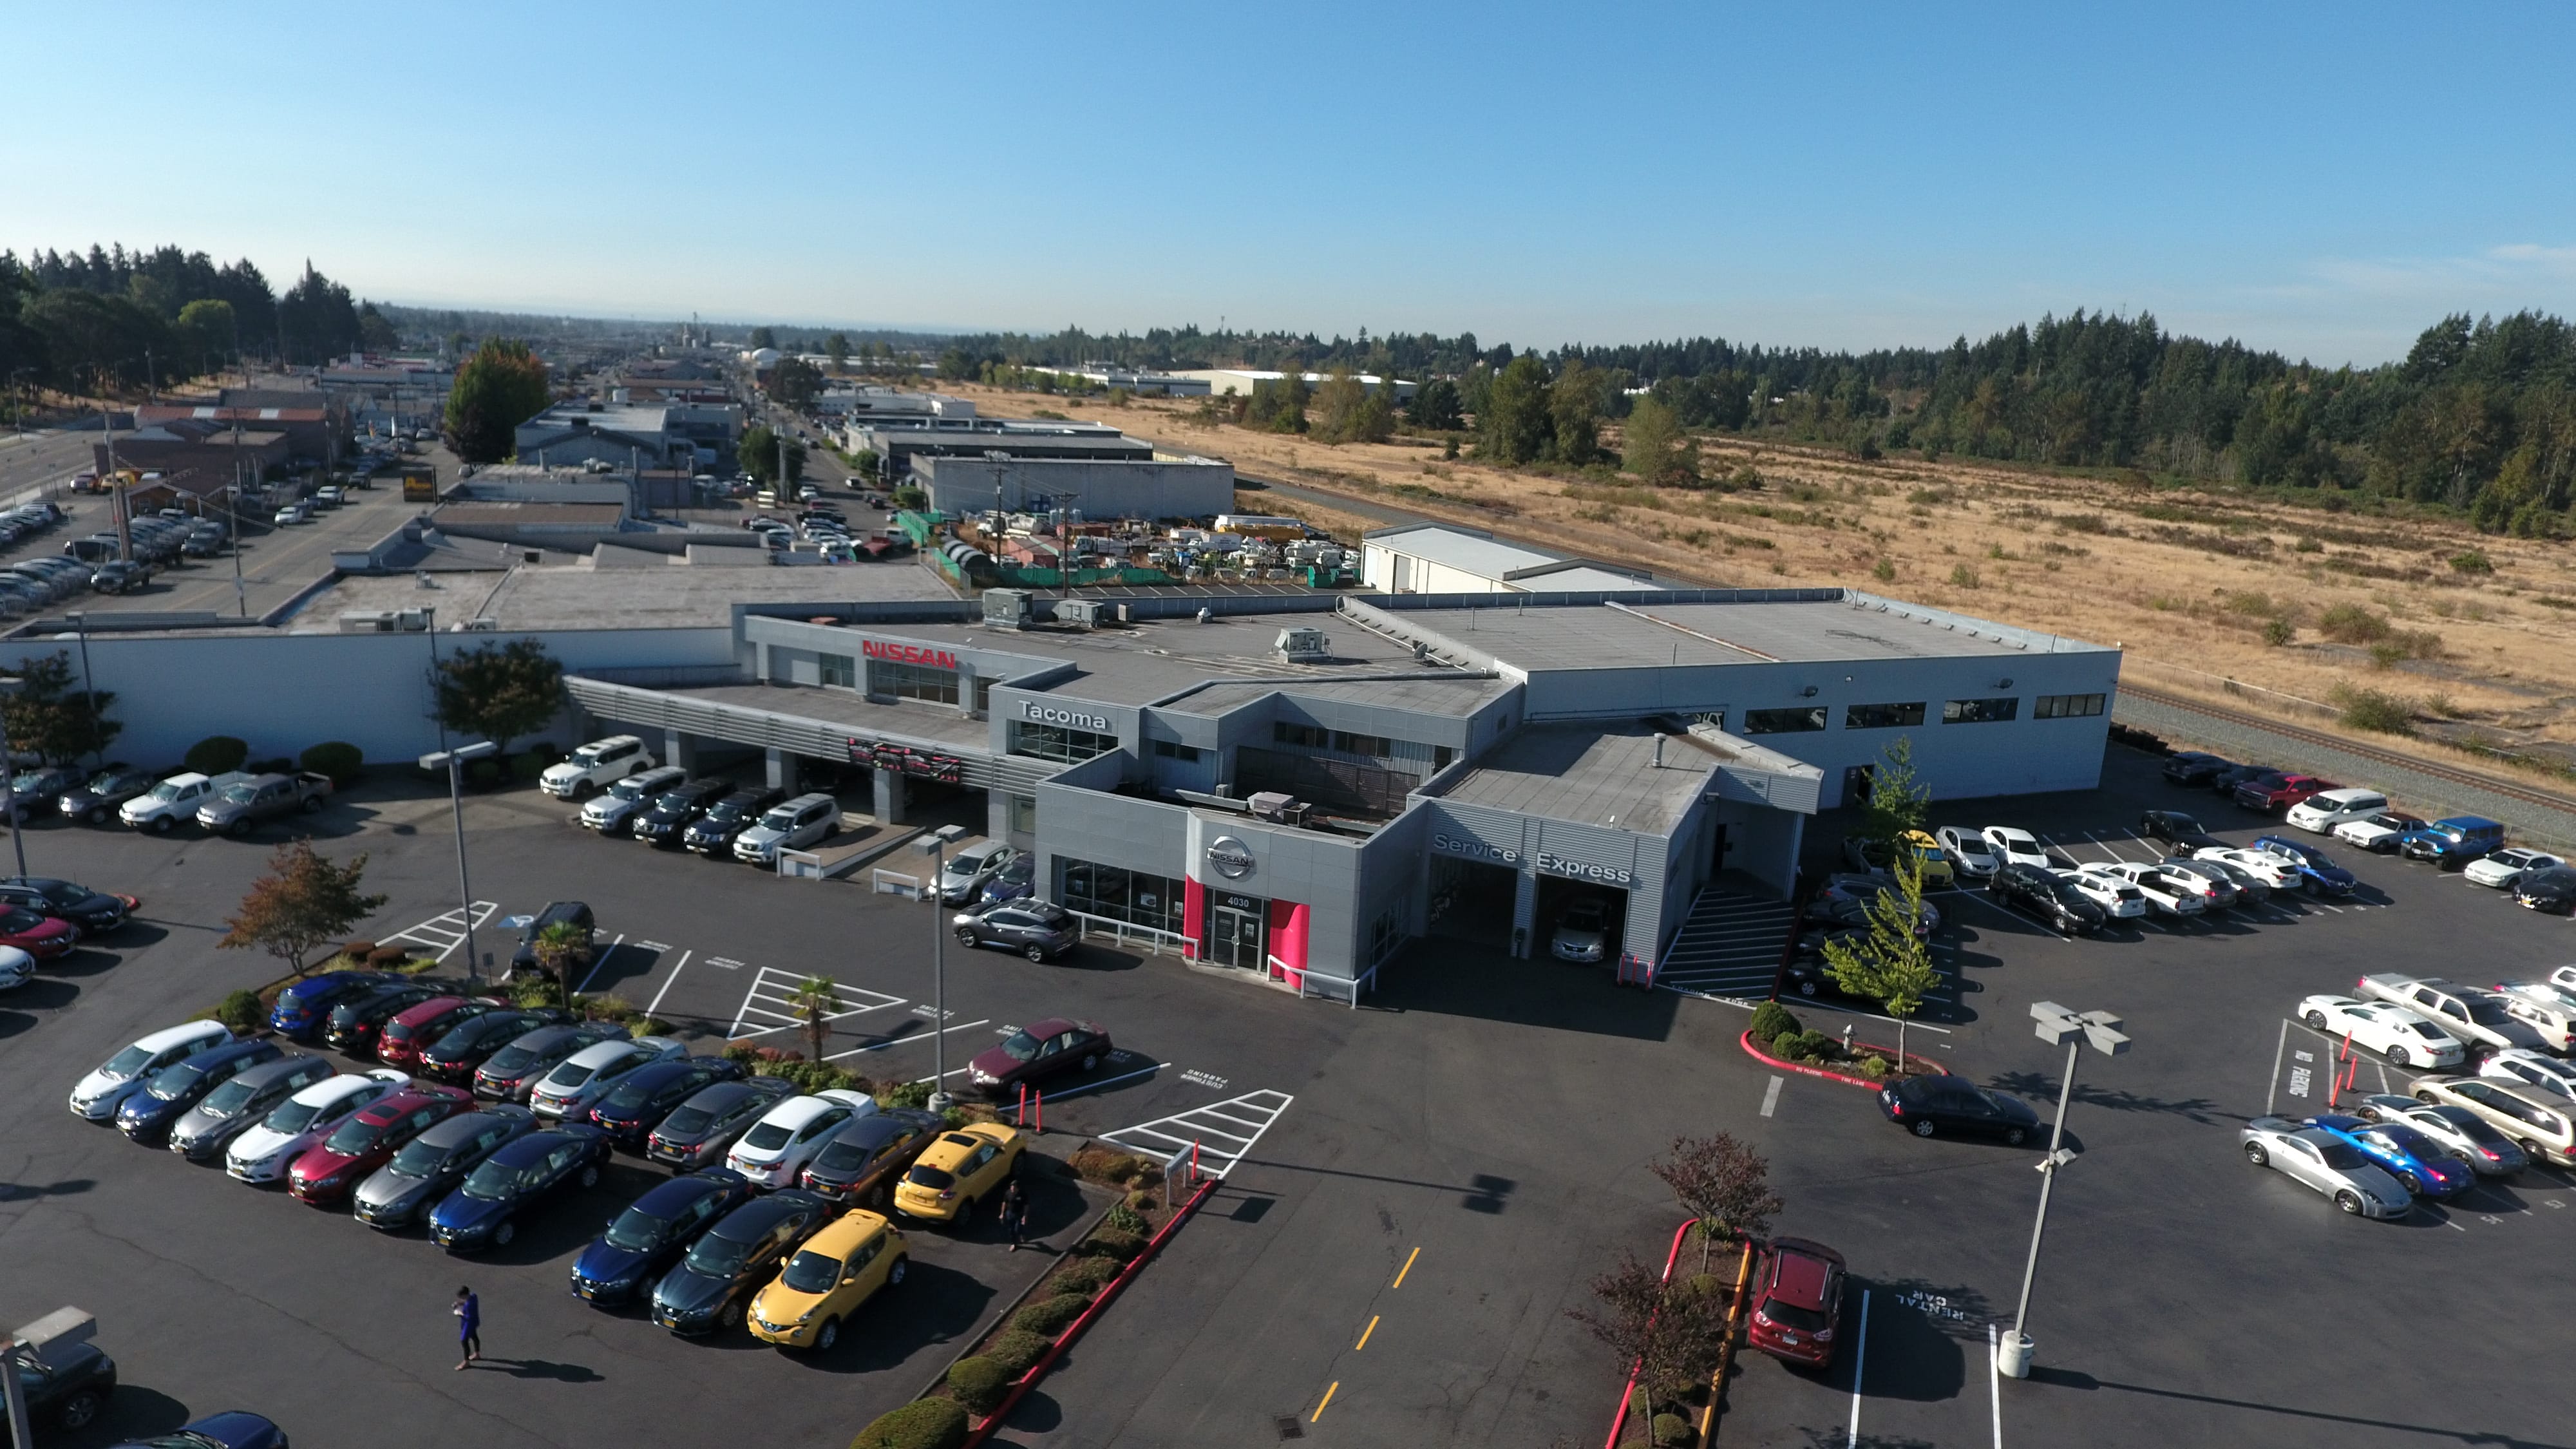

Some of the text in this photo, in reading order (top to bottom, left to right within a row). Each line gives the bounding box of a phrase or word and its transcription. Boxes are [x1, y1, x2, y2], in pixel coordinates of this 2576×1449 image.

[863, 639, 955, 669] NISSAN
[1018, 699, 1106, 730] Tacoma
[1210, 851, 1249, 865] NISSAN
[1433, 834, 1631, 883] Service Express
[1227, 896, 1249, 907] 4030
[1180, 1073, 1223, 1089] CUSTOMER
[1187, 1069, 1228, 1084] PARKING
[2289, 1066, 2311, 1098] PARKING
[1895, 1294, 1964, 1321] RENTAL
[1913, 1290, 1947, 1307] CAR
